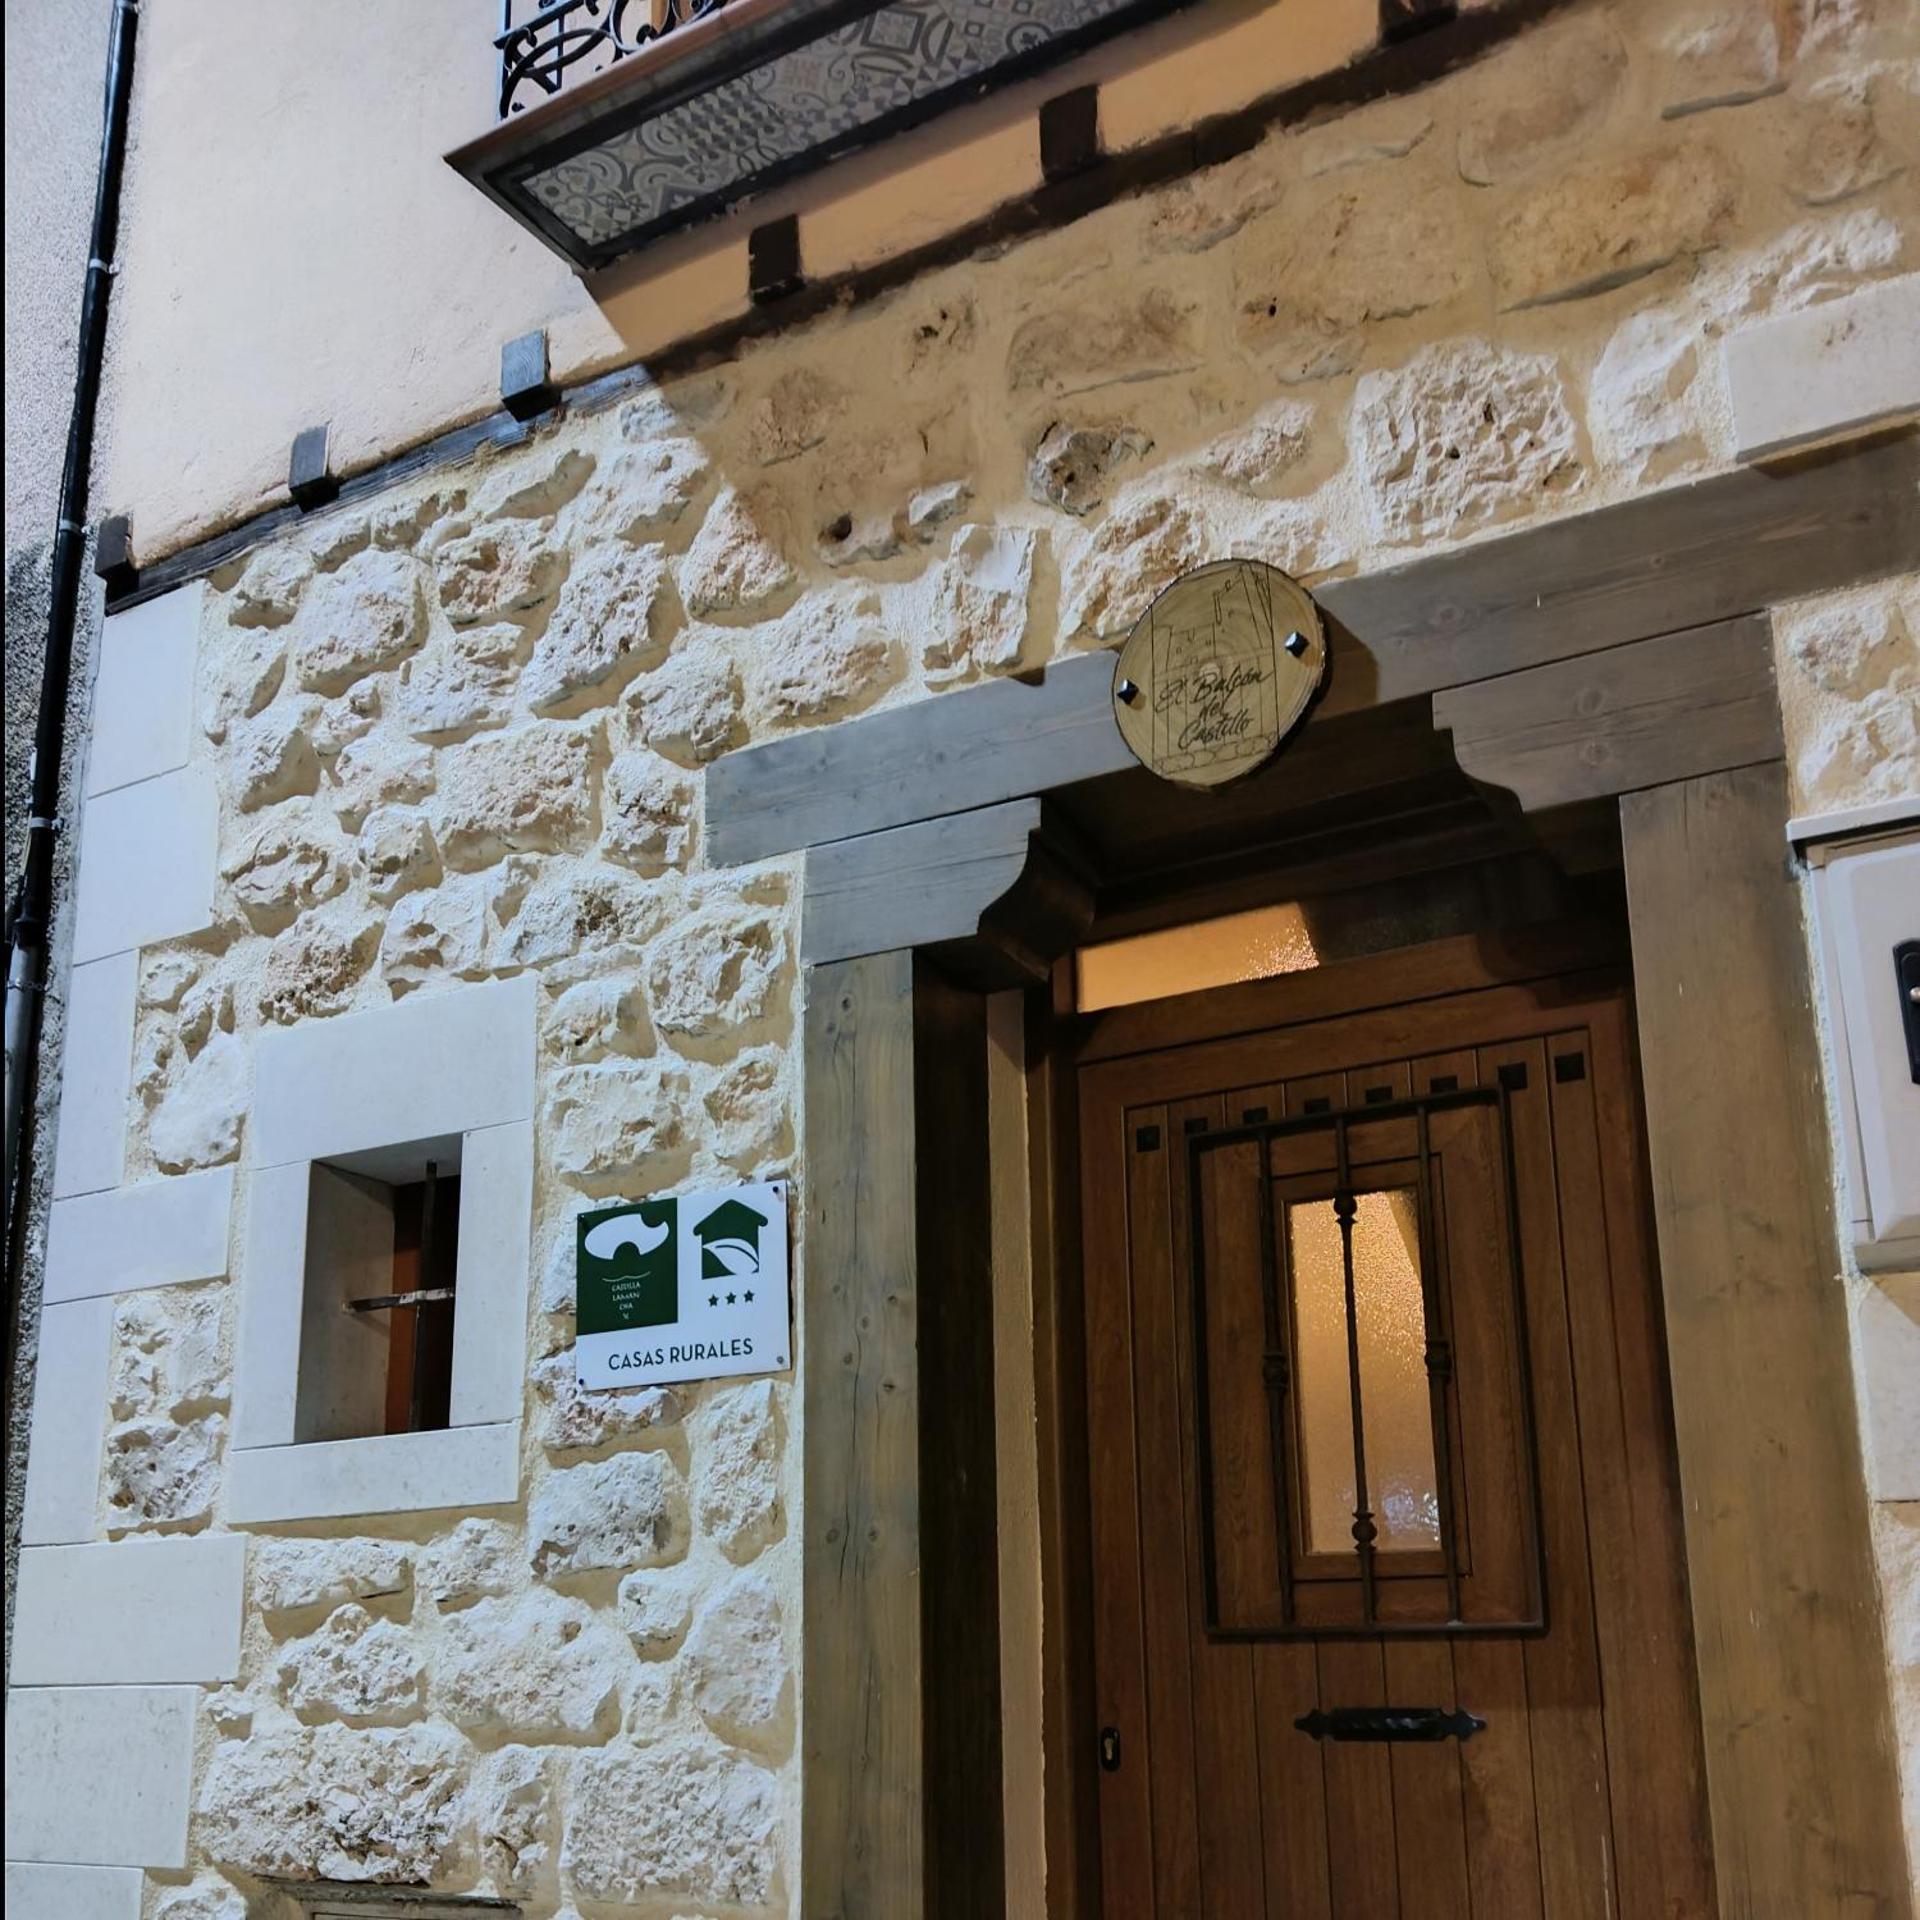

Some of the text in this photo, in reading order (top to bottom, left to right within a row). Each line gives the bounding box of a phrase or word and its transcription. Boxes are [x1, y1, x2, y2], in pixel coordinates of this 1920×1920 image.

[1155, 663, 1275, 713] El Balcón
[1198, 696, 1228, 722] del
[1178, 708, 1254, 750] Castillo
[608, 1338, 753, 1370] CASAS RURALES
